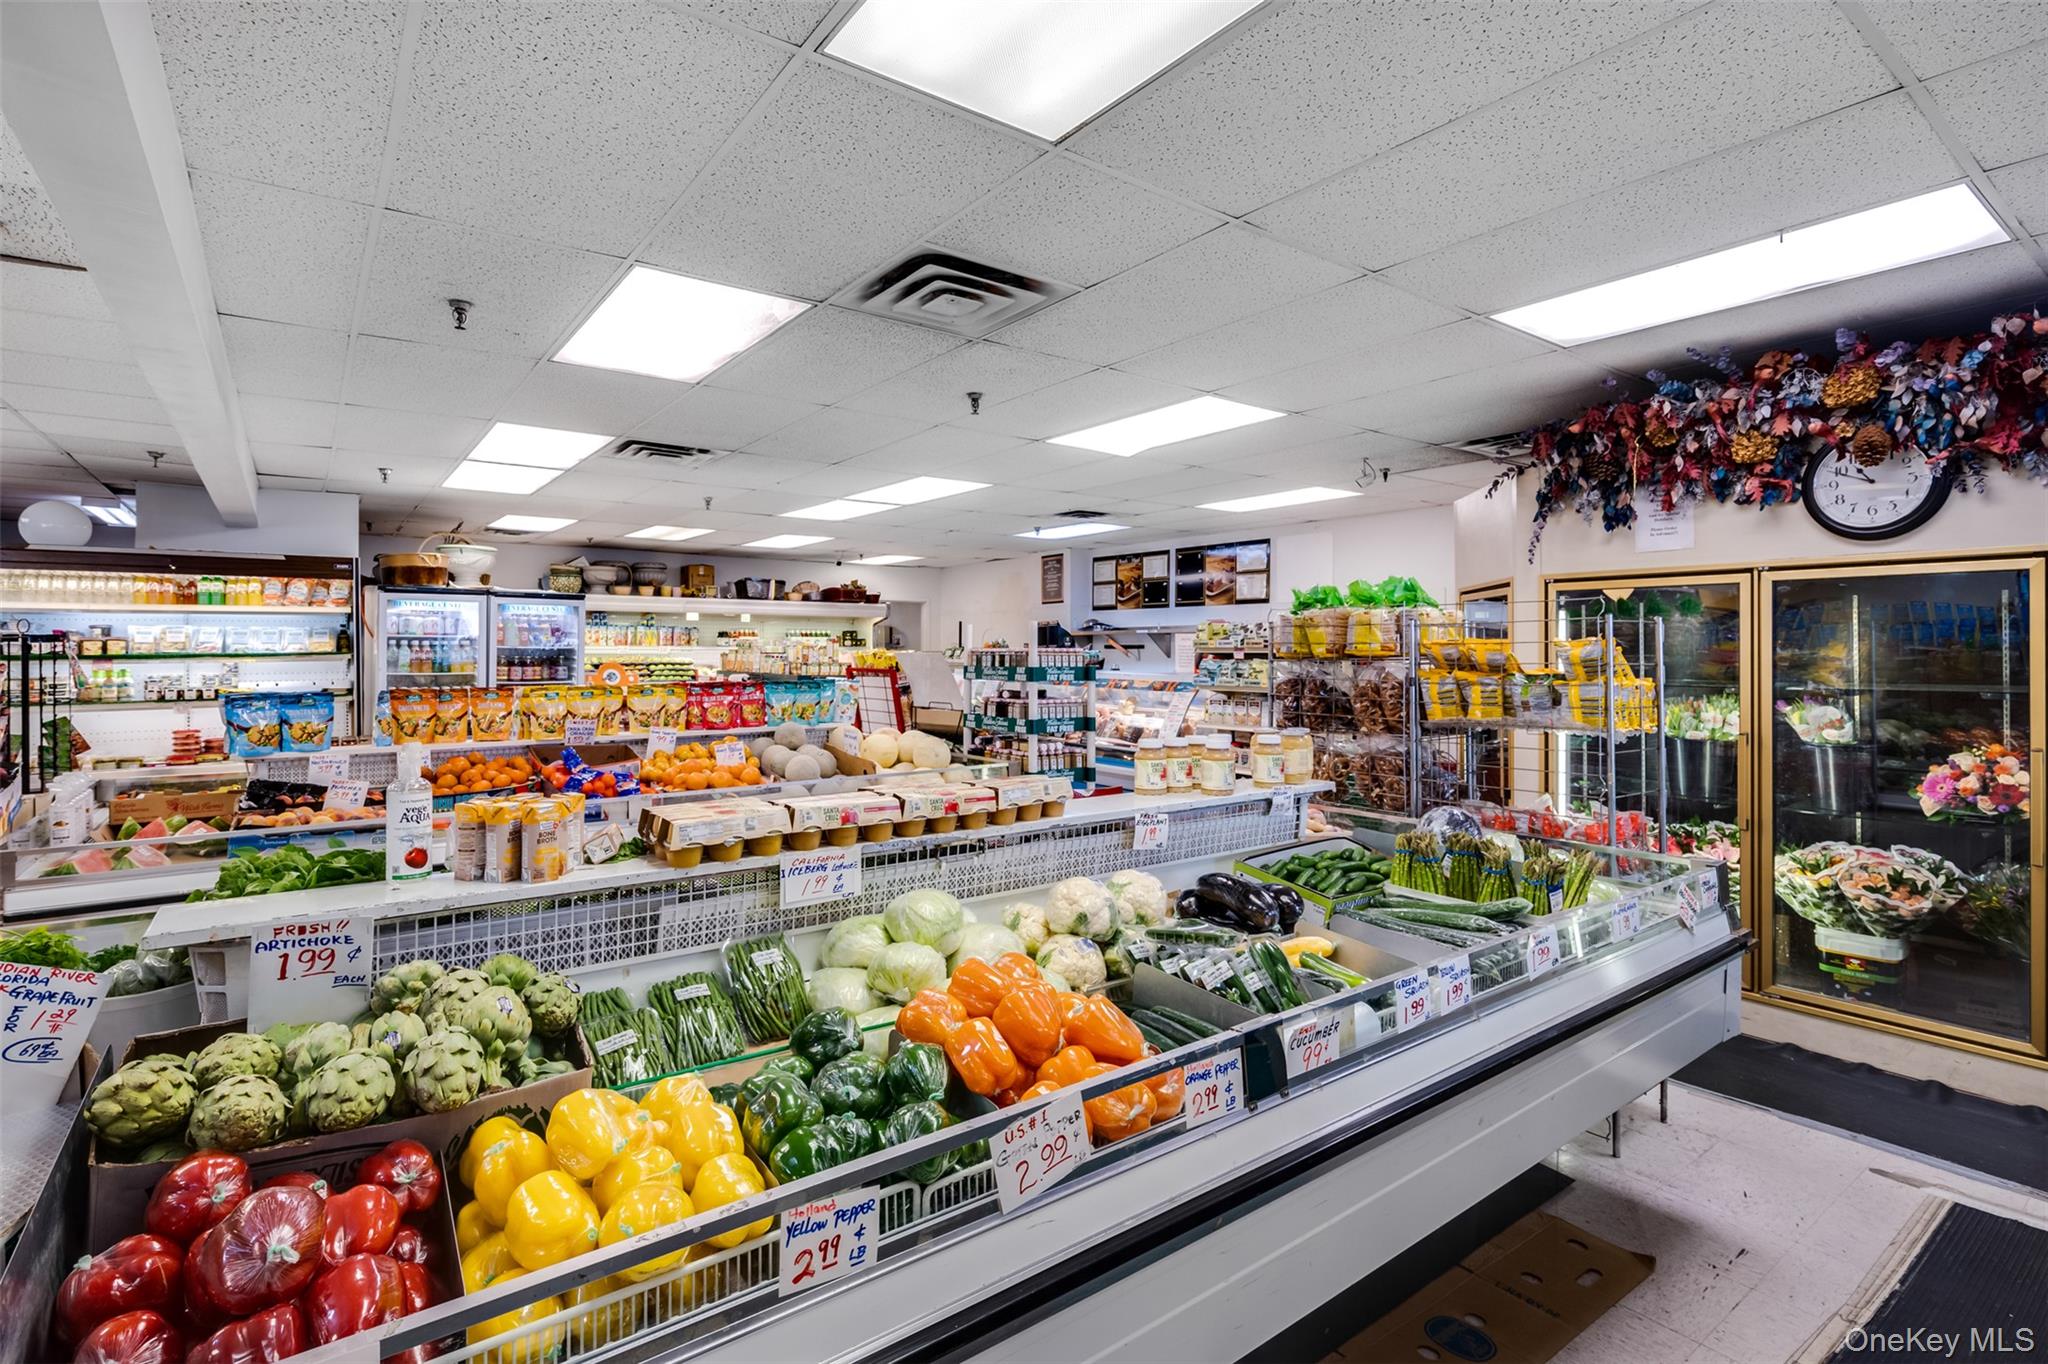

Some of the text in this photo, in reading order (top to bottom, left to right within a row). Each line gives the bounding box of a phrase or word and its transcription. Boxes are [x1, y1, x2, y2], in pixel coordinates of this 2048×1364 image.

[1834, 466, 1848, 477] 10
[1829, 480, 1839, 490] 9
[1834, 494, 1845, 505] 8
[1887, 500, 1898, 511] 5
[1850, 502, 1859, 513] 7
[1867, 505, 1878, 516] 6
[400, 812, 431, 824] AQUA
[538, 830, 556, 838] BONE
[536, 836, 558, 845] BROTH
[788, 863, 828, 878] ICEBERG
[255, 935, 354, 953] ARTICHOKE
[0, 974, 50, 986] ORIDA
[49, 966, 98, 985] RIVER
[333, 975, 367, 984] EACH
[1395, 975, 1418, 990] GREEN
[1290, 1016, 1340, 1050] CUCUMBER
[1185, 1058, 1241, 1086] ORANGE PEPPER
[785, 1198, 876, 1249] YELLOW PEPPER
[849, 1245, 867, 1262] LB
